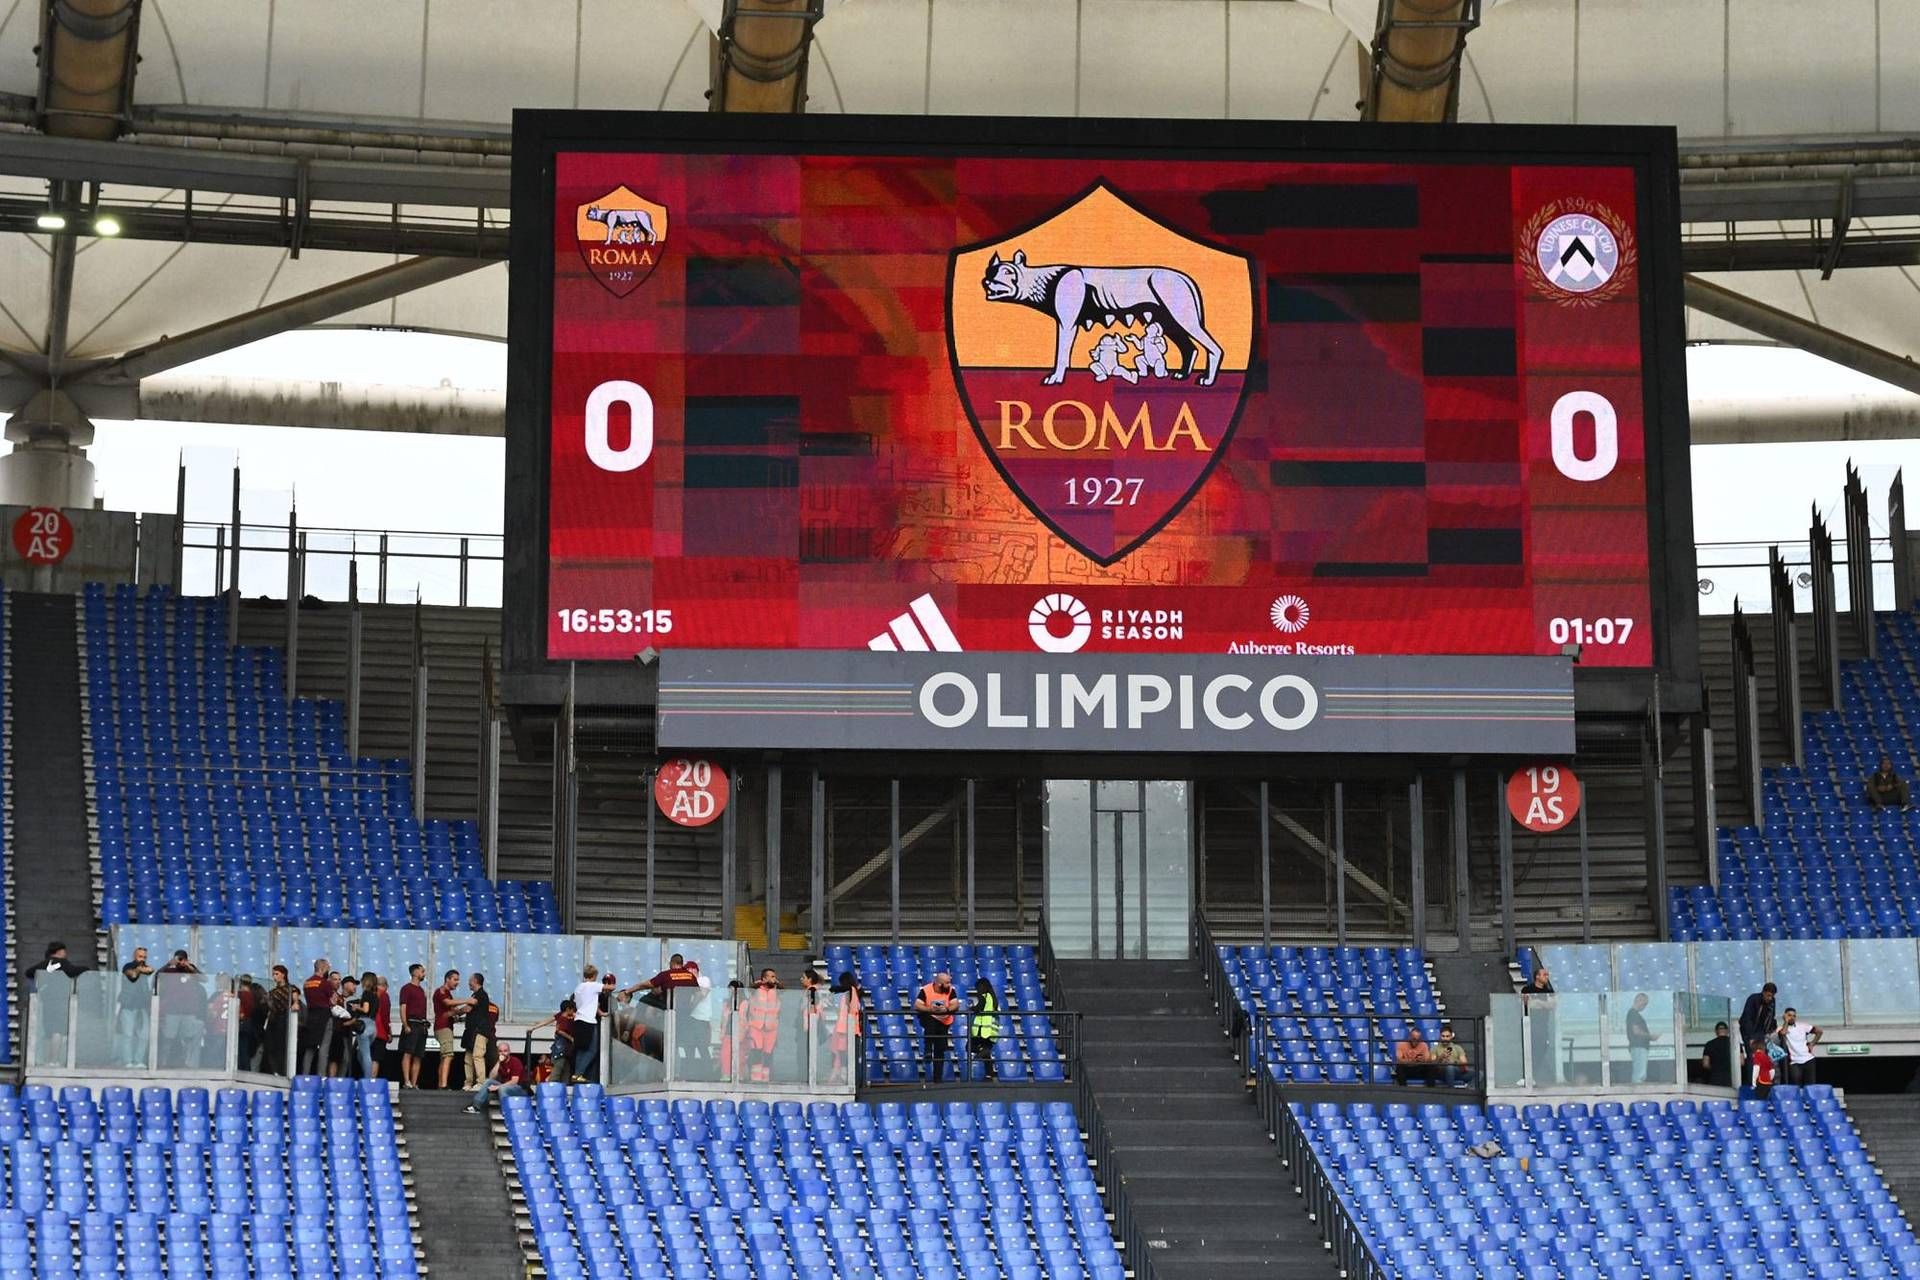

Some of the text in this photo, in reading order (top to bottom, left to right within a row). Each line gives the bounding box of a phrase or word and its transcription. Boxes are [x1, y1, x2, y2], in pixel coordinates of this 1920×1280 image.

[1557, 197, 1594, 213] 1896
[1541, 219, 1613, 253] UDINESE CALCIO
[590, 249, 653, 265] ROMA
[609, 272, 633, 281] 1927
[585, 380, 653, 472] 0
[995, 400, 1212, 451] ROMA
[1550, 391, 1618, 481] 0
[1064, 477, 1144, 506] 1927
[30, 512, 59, 535] 20
[27, 536, 61, 559] AS
[558, 608, 673, 633] 16:53:15
[1101, 609, 1183, 624] RIYADH
[1101, 625, 1183, 640] SEASON
[1549, 617, 1633, 644] 01:07
[1227, 641, 1355, 656] Auberge Resorts
[919, 672, 1319, 731] OLIMPICO
[676, 759, 711, 788] 20
[1526, 766, 1560, 794] 19
[670, 790, 715, 818] AD
[1525, 796, 1564, 825] AS
